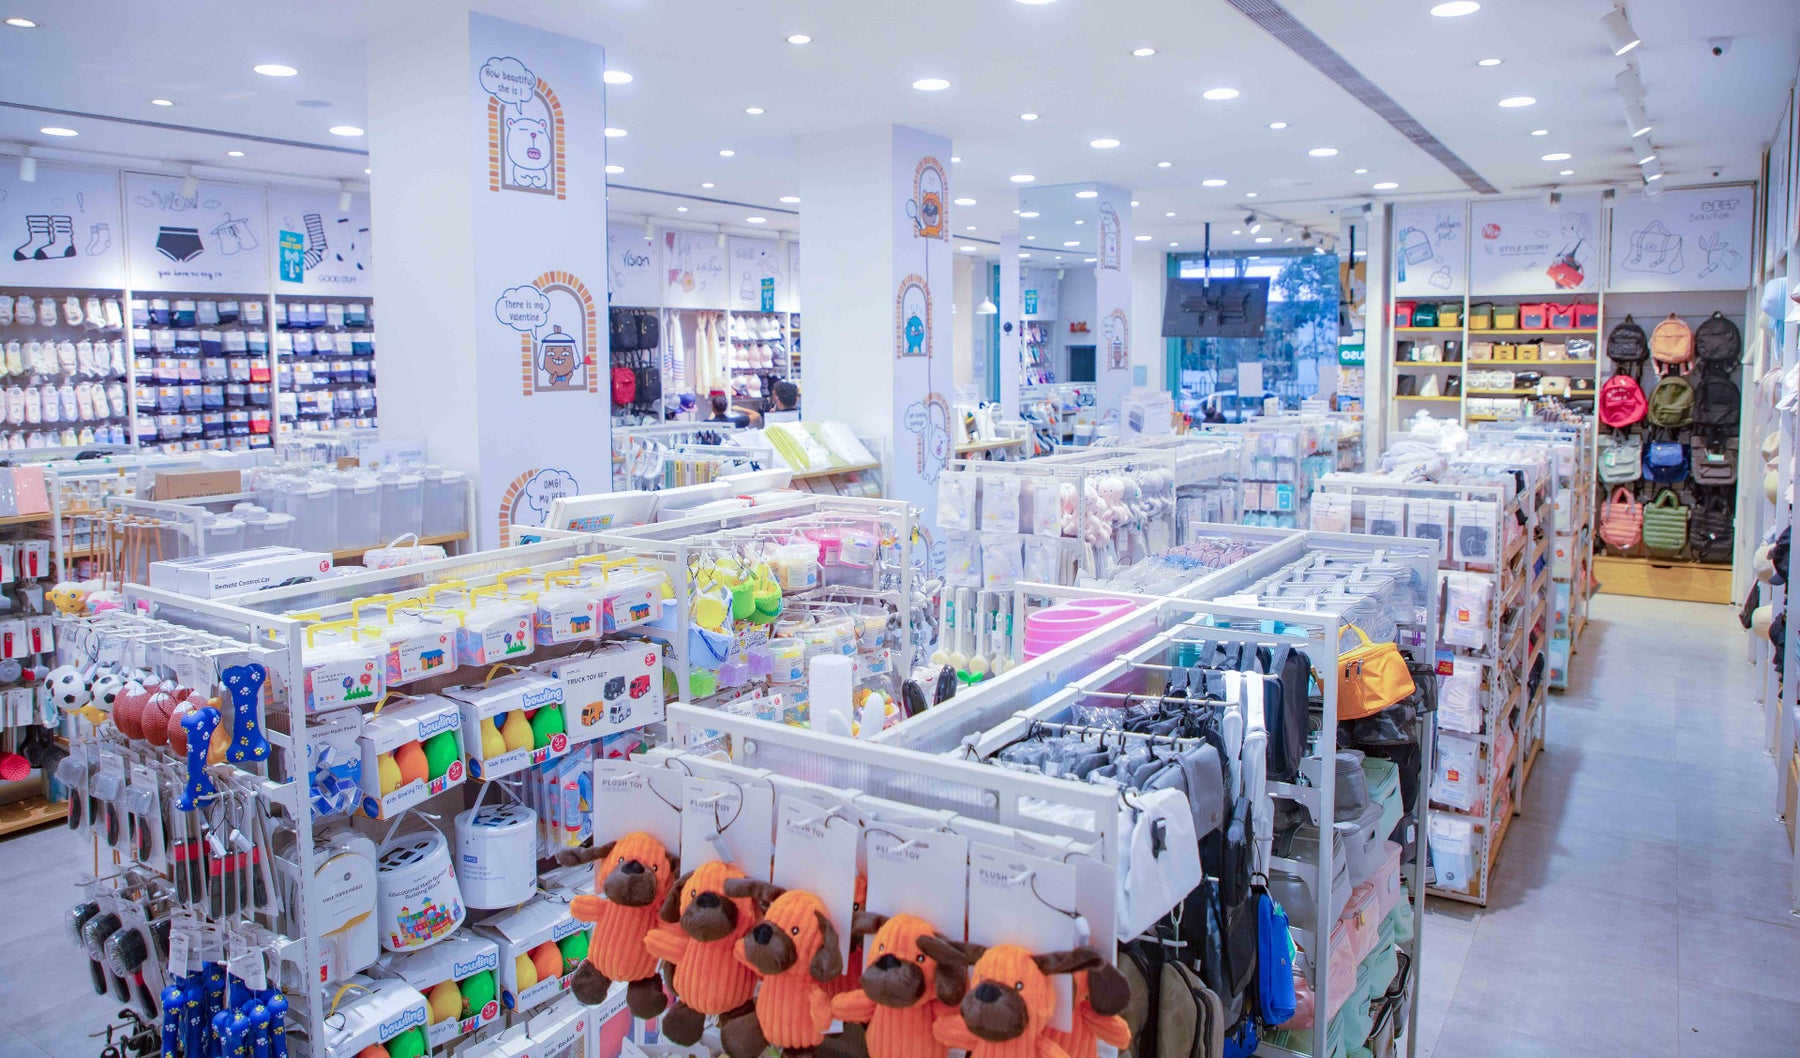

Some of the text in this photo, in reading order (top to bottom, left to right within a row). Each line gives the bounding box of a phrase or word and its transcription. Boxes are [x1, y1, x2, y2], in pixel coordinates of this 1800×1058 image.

[485, 68, 534, 86] How beautiful
[497, 84, 510, 94] she
[511, 87, 518, 95] is
[622, 249, 650, 268] Vision
[504, 300, 544, 312] There is my
[509, 313, 540, 322] Valentine
[214, 581, 238, 590] Remote
[238, 578, 260, 587] Control
[567, 676, 586, 685] TRUCK
[597, 671, 608, 679] SET
[522, 687, 564, 709] bowling
[418, 712, 459, 738] bowling
[602, 779, 643, 789] PLUSH TOY
[690, 799, 730, 811] PLUSH TOY
[904, 850, 920, 860] TOY
[979, 868, 1008, 881] PLUSH
[453, 952, 497, 979] bowling
[379, 1005, 426, 1041] bowling
